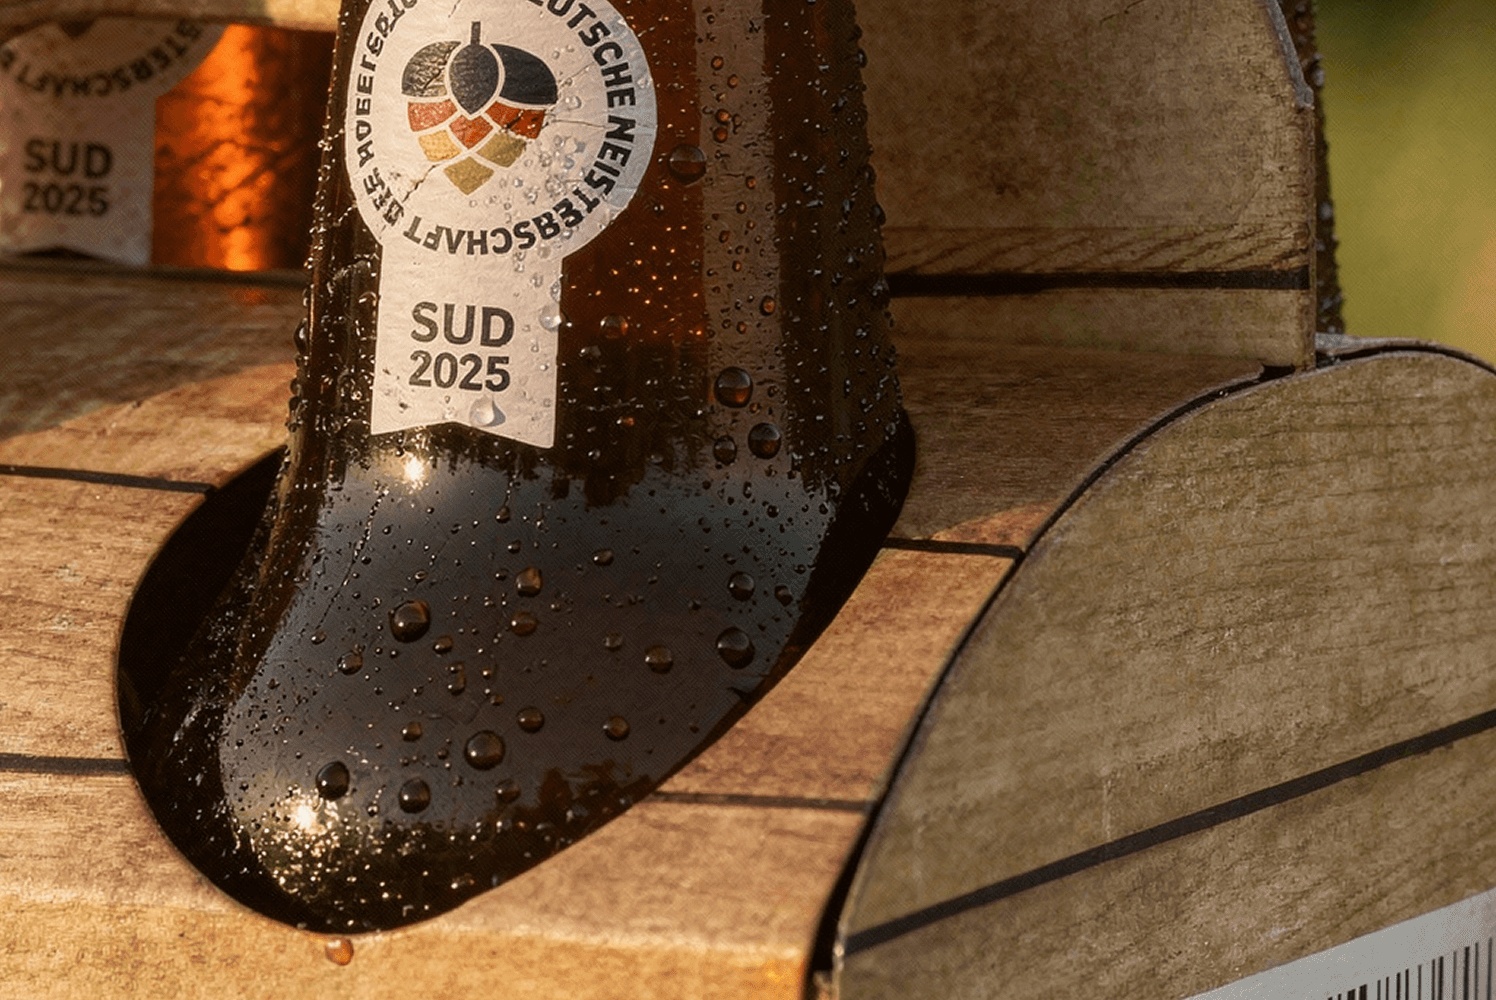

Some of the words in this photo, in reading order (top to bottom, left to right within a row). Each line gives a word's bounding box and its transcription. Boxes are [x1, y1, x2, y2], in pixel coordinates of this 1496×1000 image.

[23, 139, 114, 180] SUD
[22, 181, 109, 217] 2025
[410, 301, 515, 348] SUD
[408, 349, 511, 392] 2025
